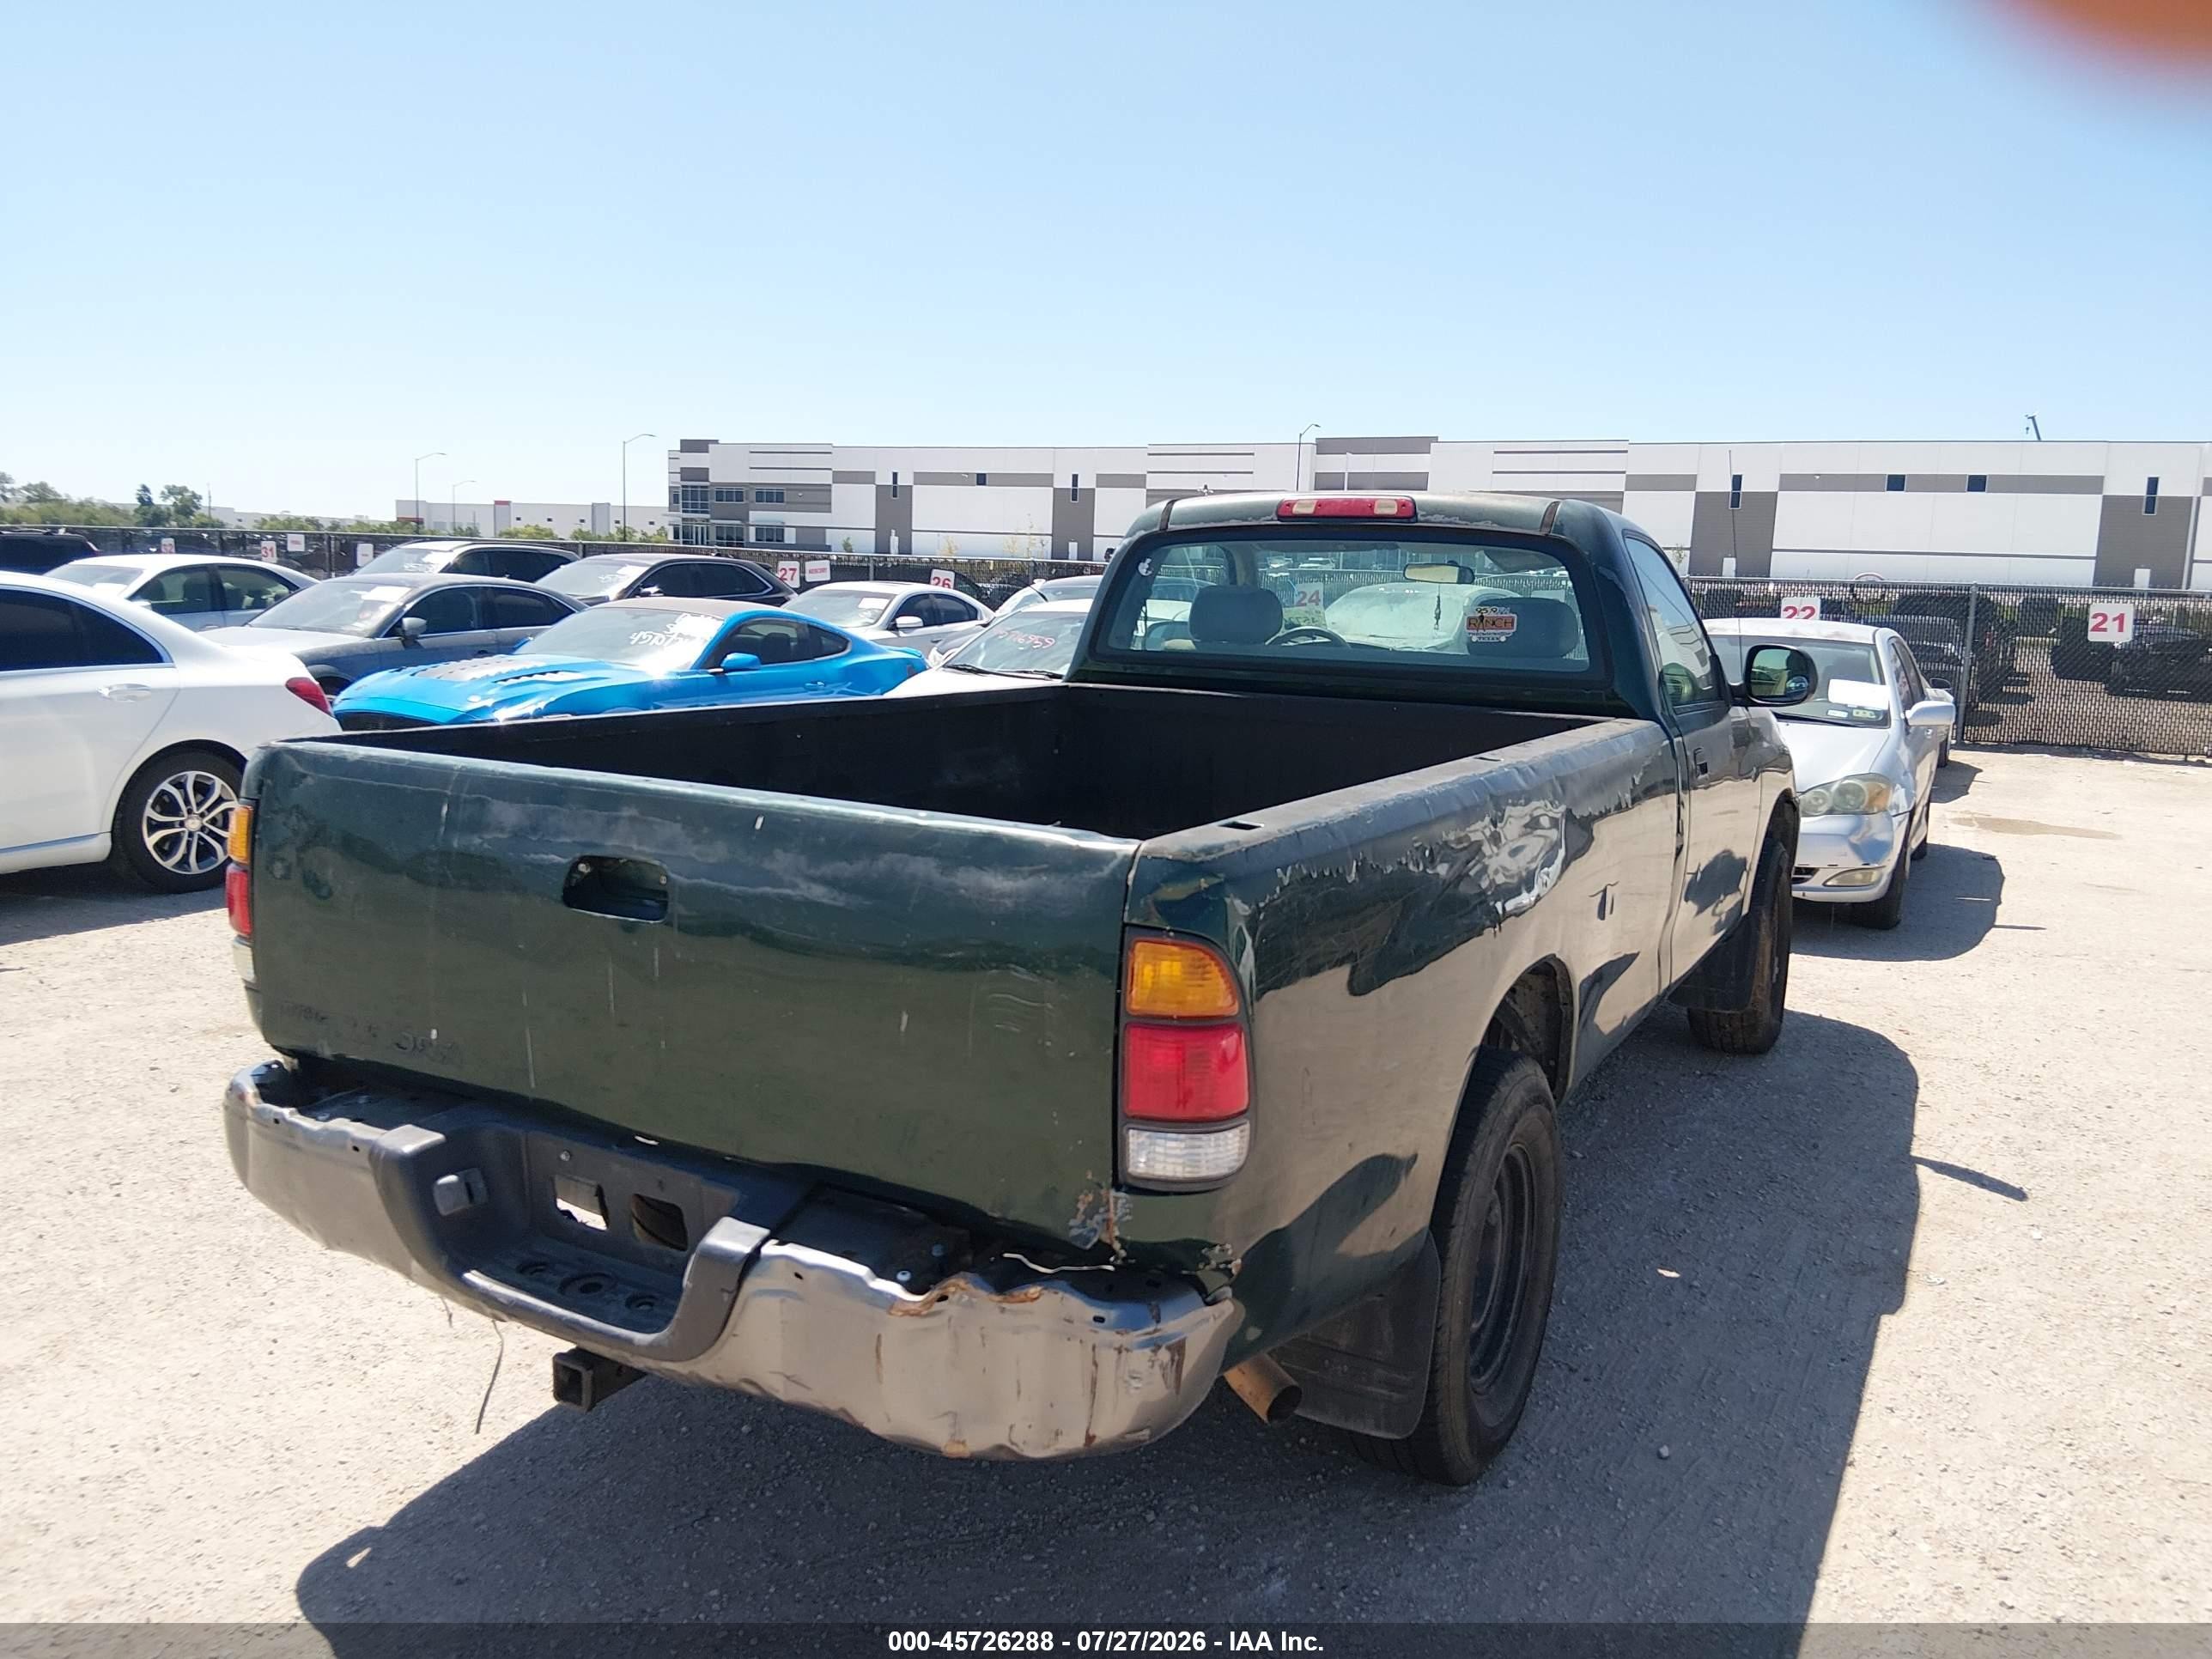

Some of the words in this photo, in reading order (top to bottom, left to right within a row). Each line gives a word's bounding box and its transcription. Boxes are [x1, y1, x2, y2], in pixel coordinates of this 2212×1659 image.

[261, 546, 274, 558] 31
[779, 568, 798, 581] 27
[1297, 590, 1321, 606] 24
[2089, 612, 2125, 633] 21
